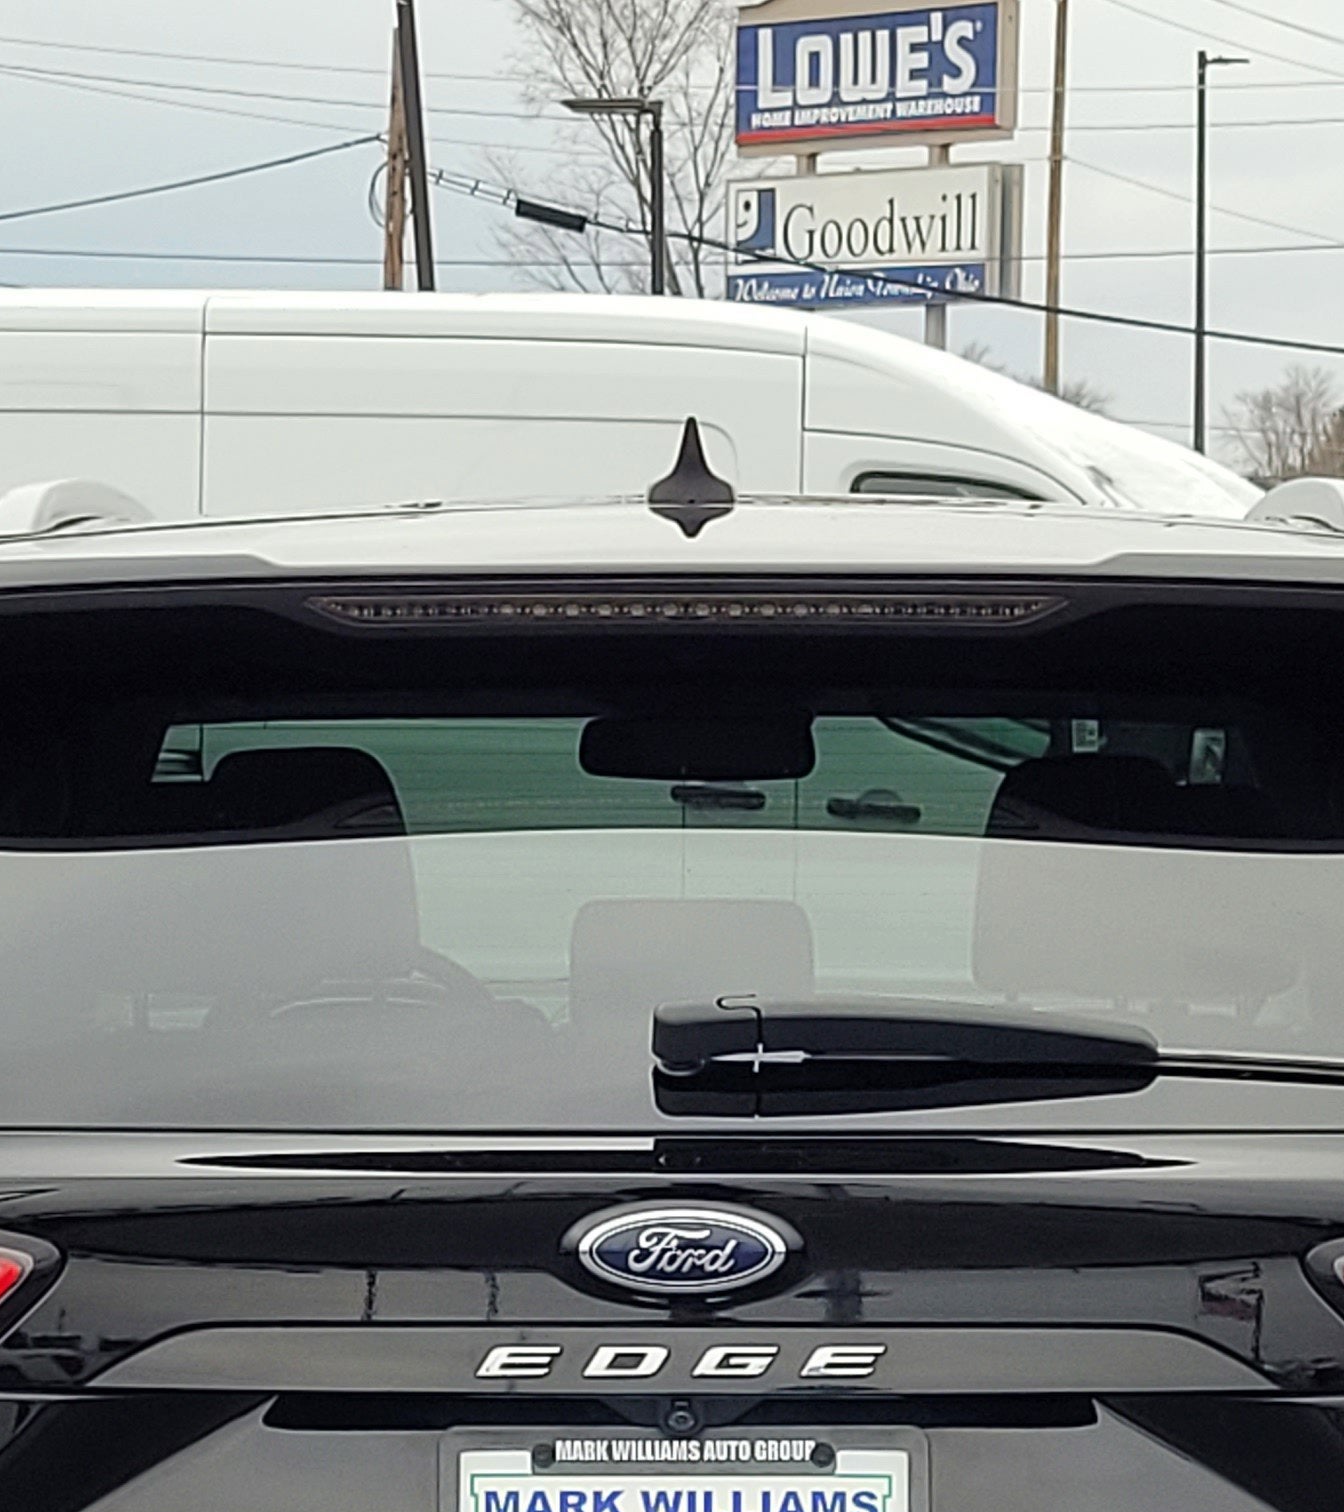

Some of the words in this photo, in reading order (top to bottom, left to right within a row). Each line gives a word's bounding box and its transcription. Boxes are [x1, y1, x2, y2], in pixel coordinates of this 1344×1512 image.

[757, 11, 977, 109] LOWE'S
[751, 110, 792, 130] HOME
[793, 102, 893, 126] IMPROVEMENT
[895, 95, 982, 118] WAREHOUSE
[782, 191, 979, 261] Goodwill
[627, 1226, 739, 1274] Ford
[475, 1345, 887, 1378] EDGE
[555, 1440, 609, 1462] MARK
[611, 1440, 701, 1462] WILLIAMS
[703, 1440, 752, 1462] AUTO
[754, 1440, 816, 1462] GROUP
